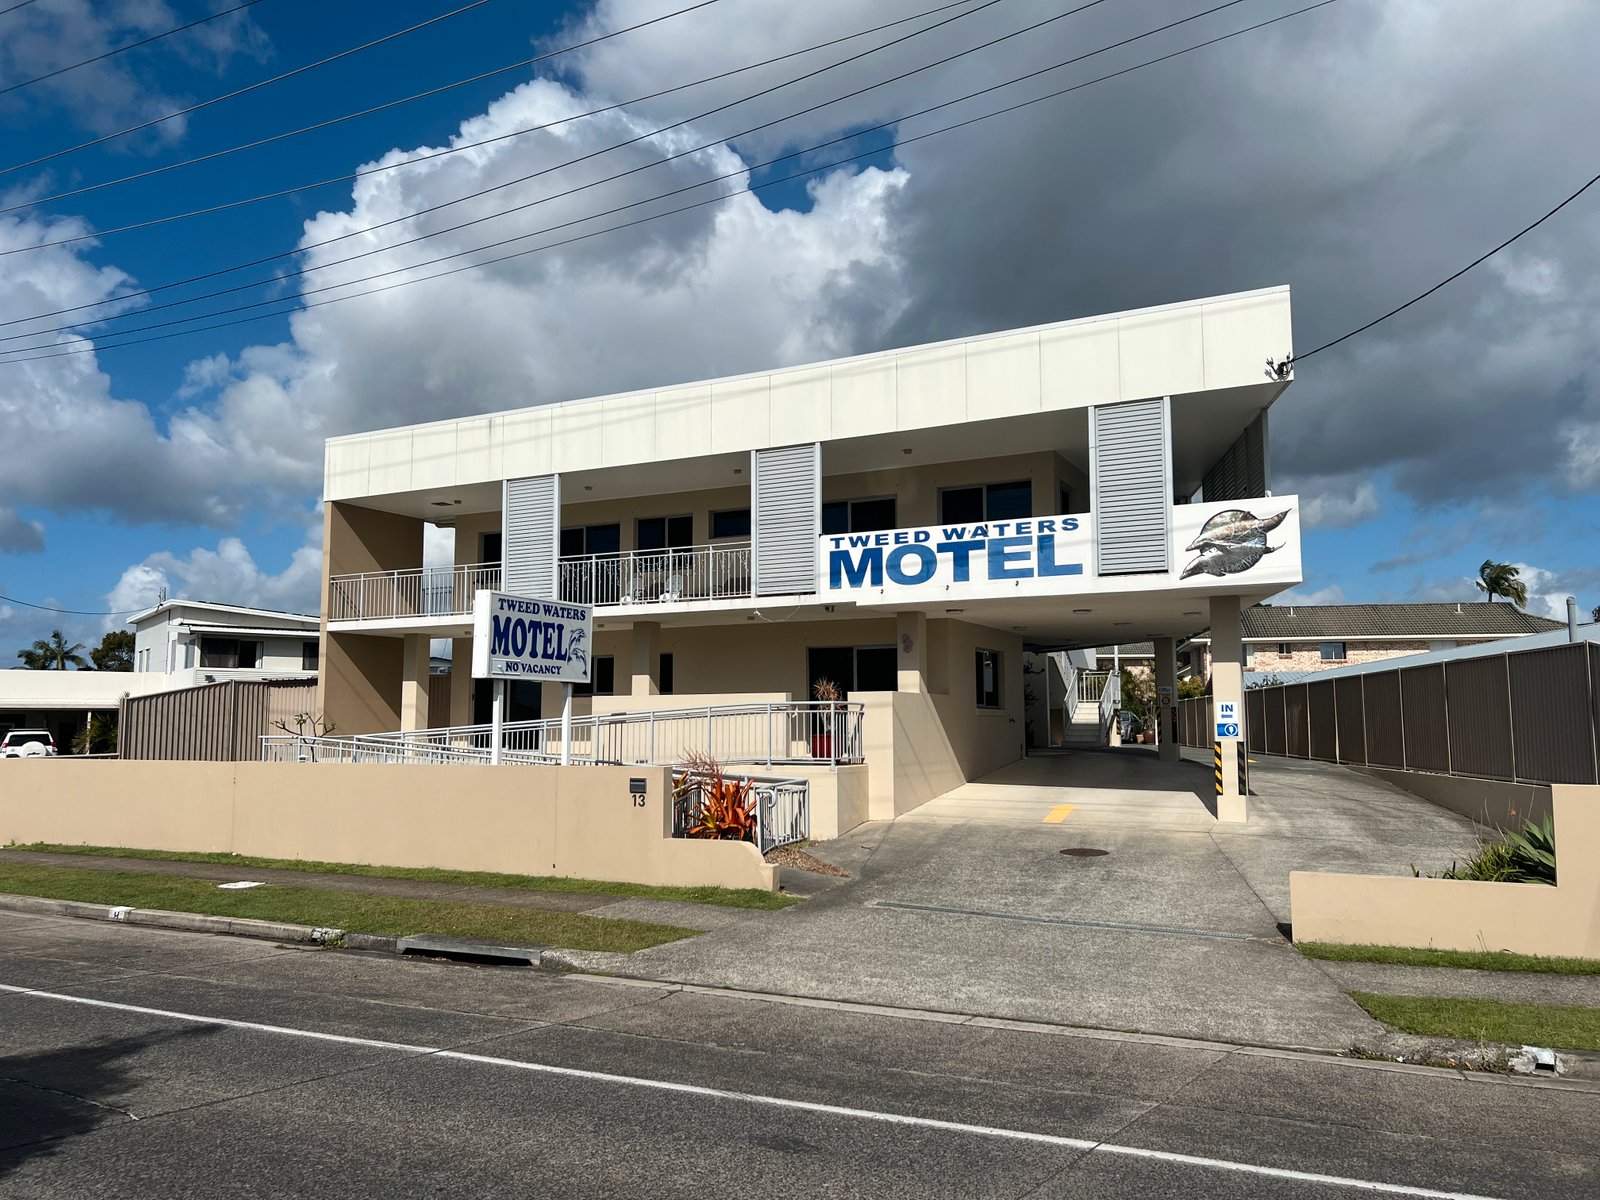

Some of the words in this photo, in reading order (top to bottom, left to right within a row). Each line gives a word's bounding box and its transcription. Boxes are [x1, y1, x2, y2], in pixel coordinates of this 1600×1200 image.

[830, 530, 930, 549] TWEED
[942, 517, 1080, 540] WATERS
[829, 534, 1084, 590] MOTEL
[498, 598, 540, 614] TWEED
[543, 604, 586, 621] WATERS
[490, 614, 568, 661] MOTEL
[505, 661, 519, 672] NO
[521, 663, 562, 675] VACANCY
[1221, 704, 1233, 712] IN
[632, 794, 645, 807] 13
